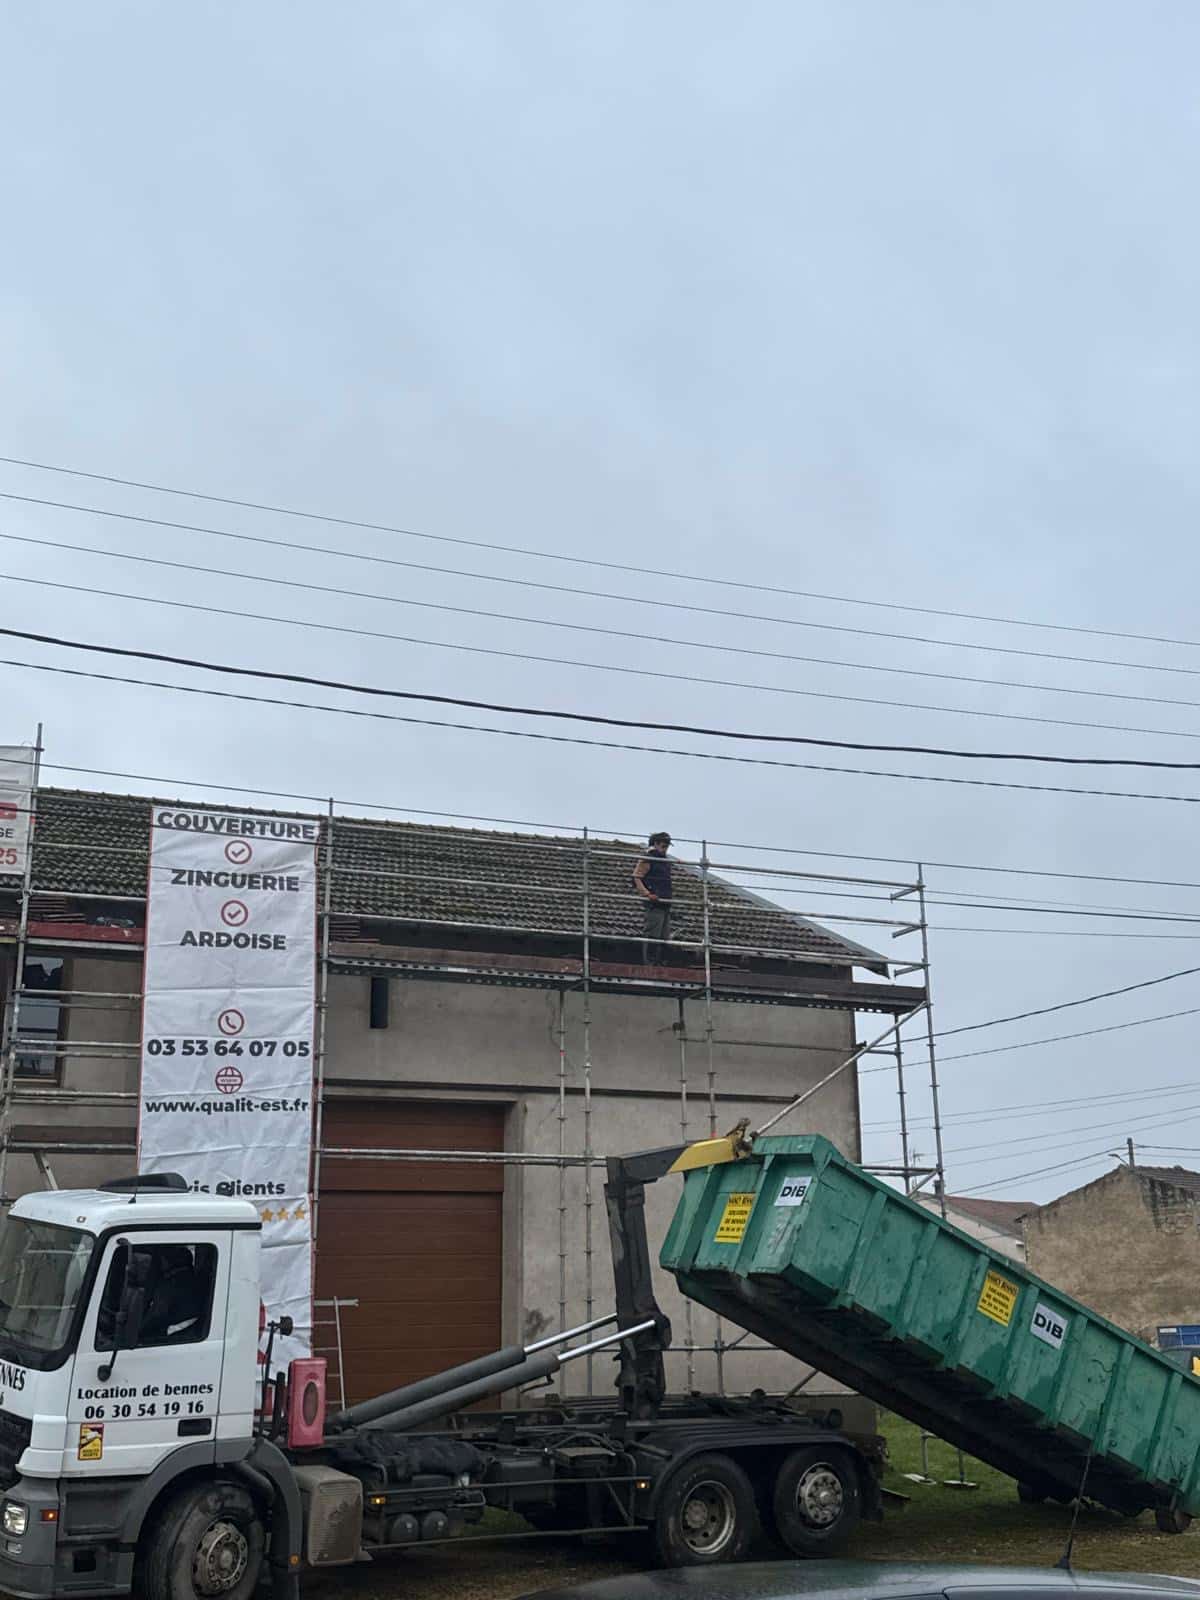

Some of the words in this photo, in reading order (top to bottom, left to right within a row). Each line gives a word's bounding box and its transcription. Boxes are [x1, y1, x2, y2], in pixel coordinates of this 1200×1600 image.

[157, 811, 316, 840] COUVERTURE
[170, 868, 300, 892] ZINGUERIE
[179, 930, 287, 950] ARDOISE
[147, 1039, 175, 1056] 03
[181, 1039, 208, 1056] 53
[214, 1040, 243, 1057] 64
[249, 1041, 277, 1057] 07
[283, 1041, 310, 1057] 05
[145, 1098, 308, 1115] www.qualit-est.fr
[780, 1186, 806, 1198] DIB
[1034, 1312, 1063, 1339] DIB
[77, 1386, 137, 1400] Location
[142, 1384, 160, 1397] de
[164, 1383, 214, 1396] bennes
[84, 1405, 105, 1419] 06
[112, 1404, 131, 1418] 30
[138, 1402, 157, 1416] 54
[164, 1401, 180, 1415] 19
[188, 1400, 204, 1414] 16
